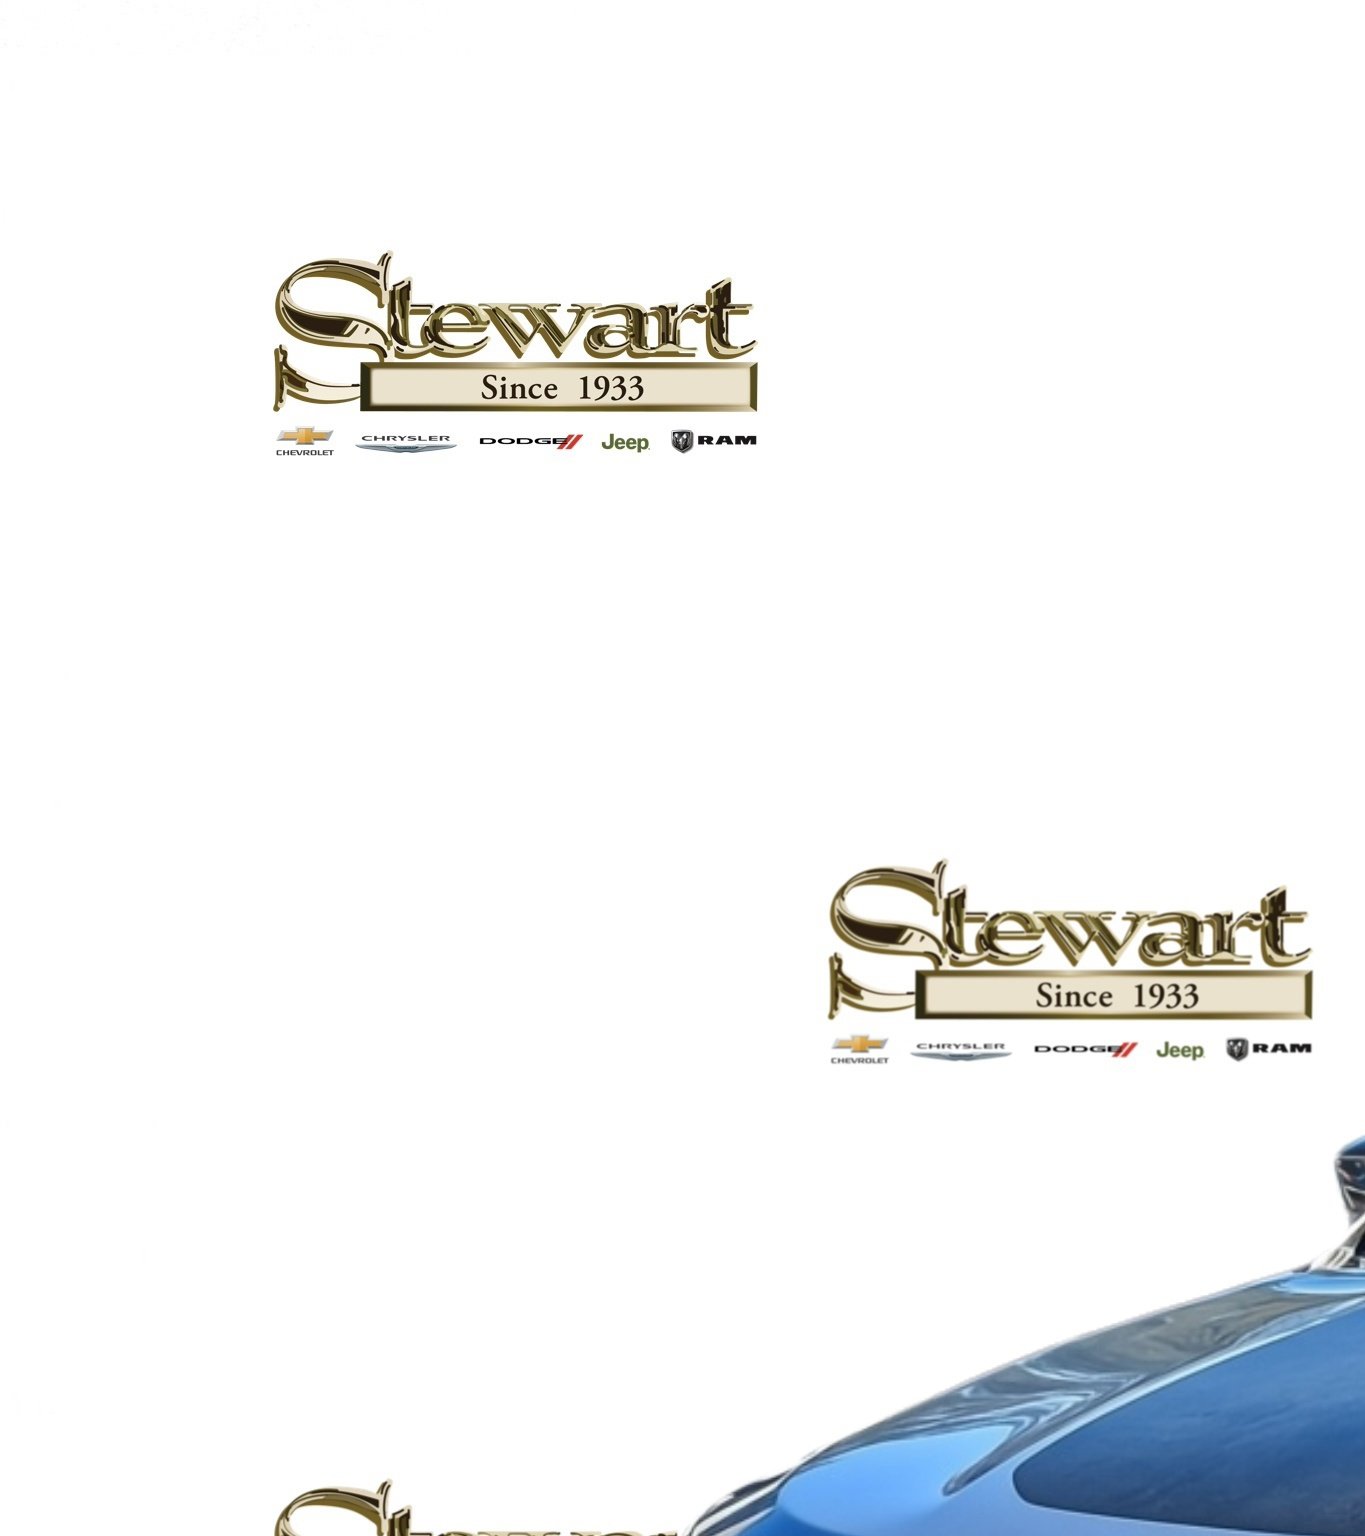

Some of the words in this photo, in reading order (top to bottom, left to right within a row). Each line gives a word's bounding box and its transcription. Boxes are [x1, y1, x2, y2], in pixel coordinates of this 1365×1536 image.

[273, 250, 757, 411] Stewart
[481, 374, 558, 400] Since
[578, 375, 645, 402] 1933
[479, 437, 568, 445] DODGE
[601, 433, 651, 453] Jeep
[697, 435, 758, 445] RAM
[828, 858, 1312, 1019] Stewart
[1036, 982, 1113, 1008] Since
[1133, 983, 1200, 1010] 1933
[1034, 1045, 1123, 1053] DODGE
[1156, 1041, 1206, 1061] Jeep
[1252, 1043, 1313, 1053] RAM
